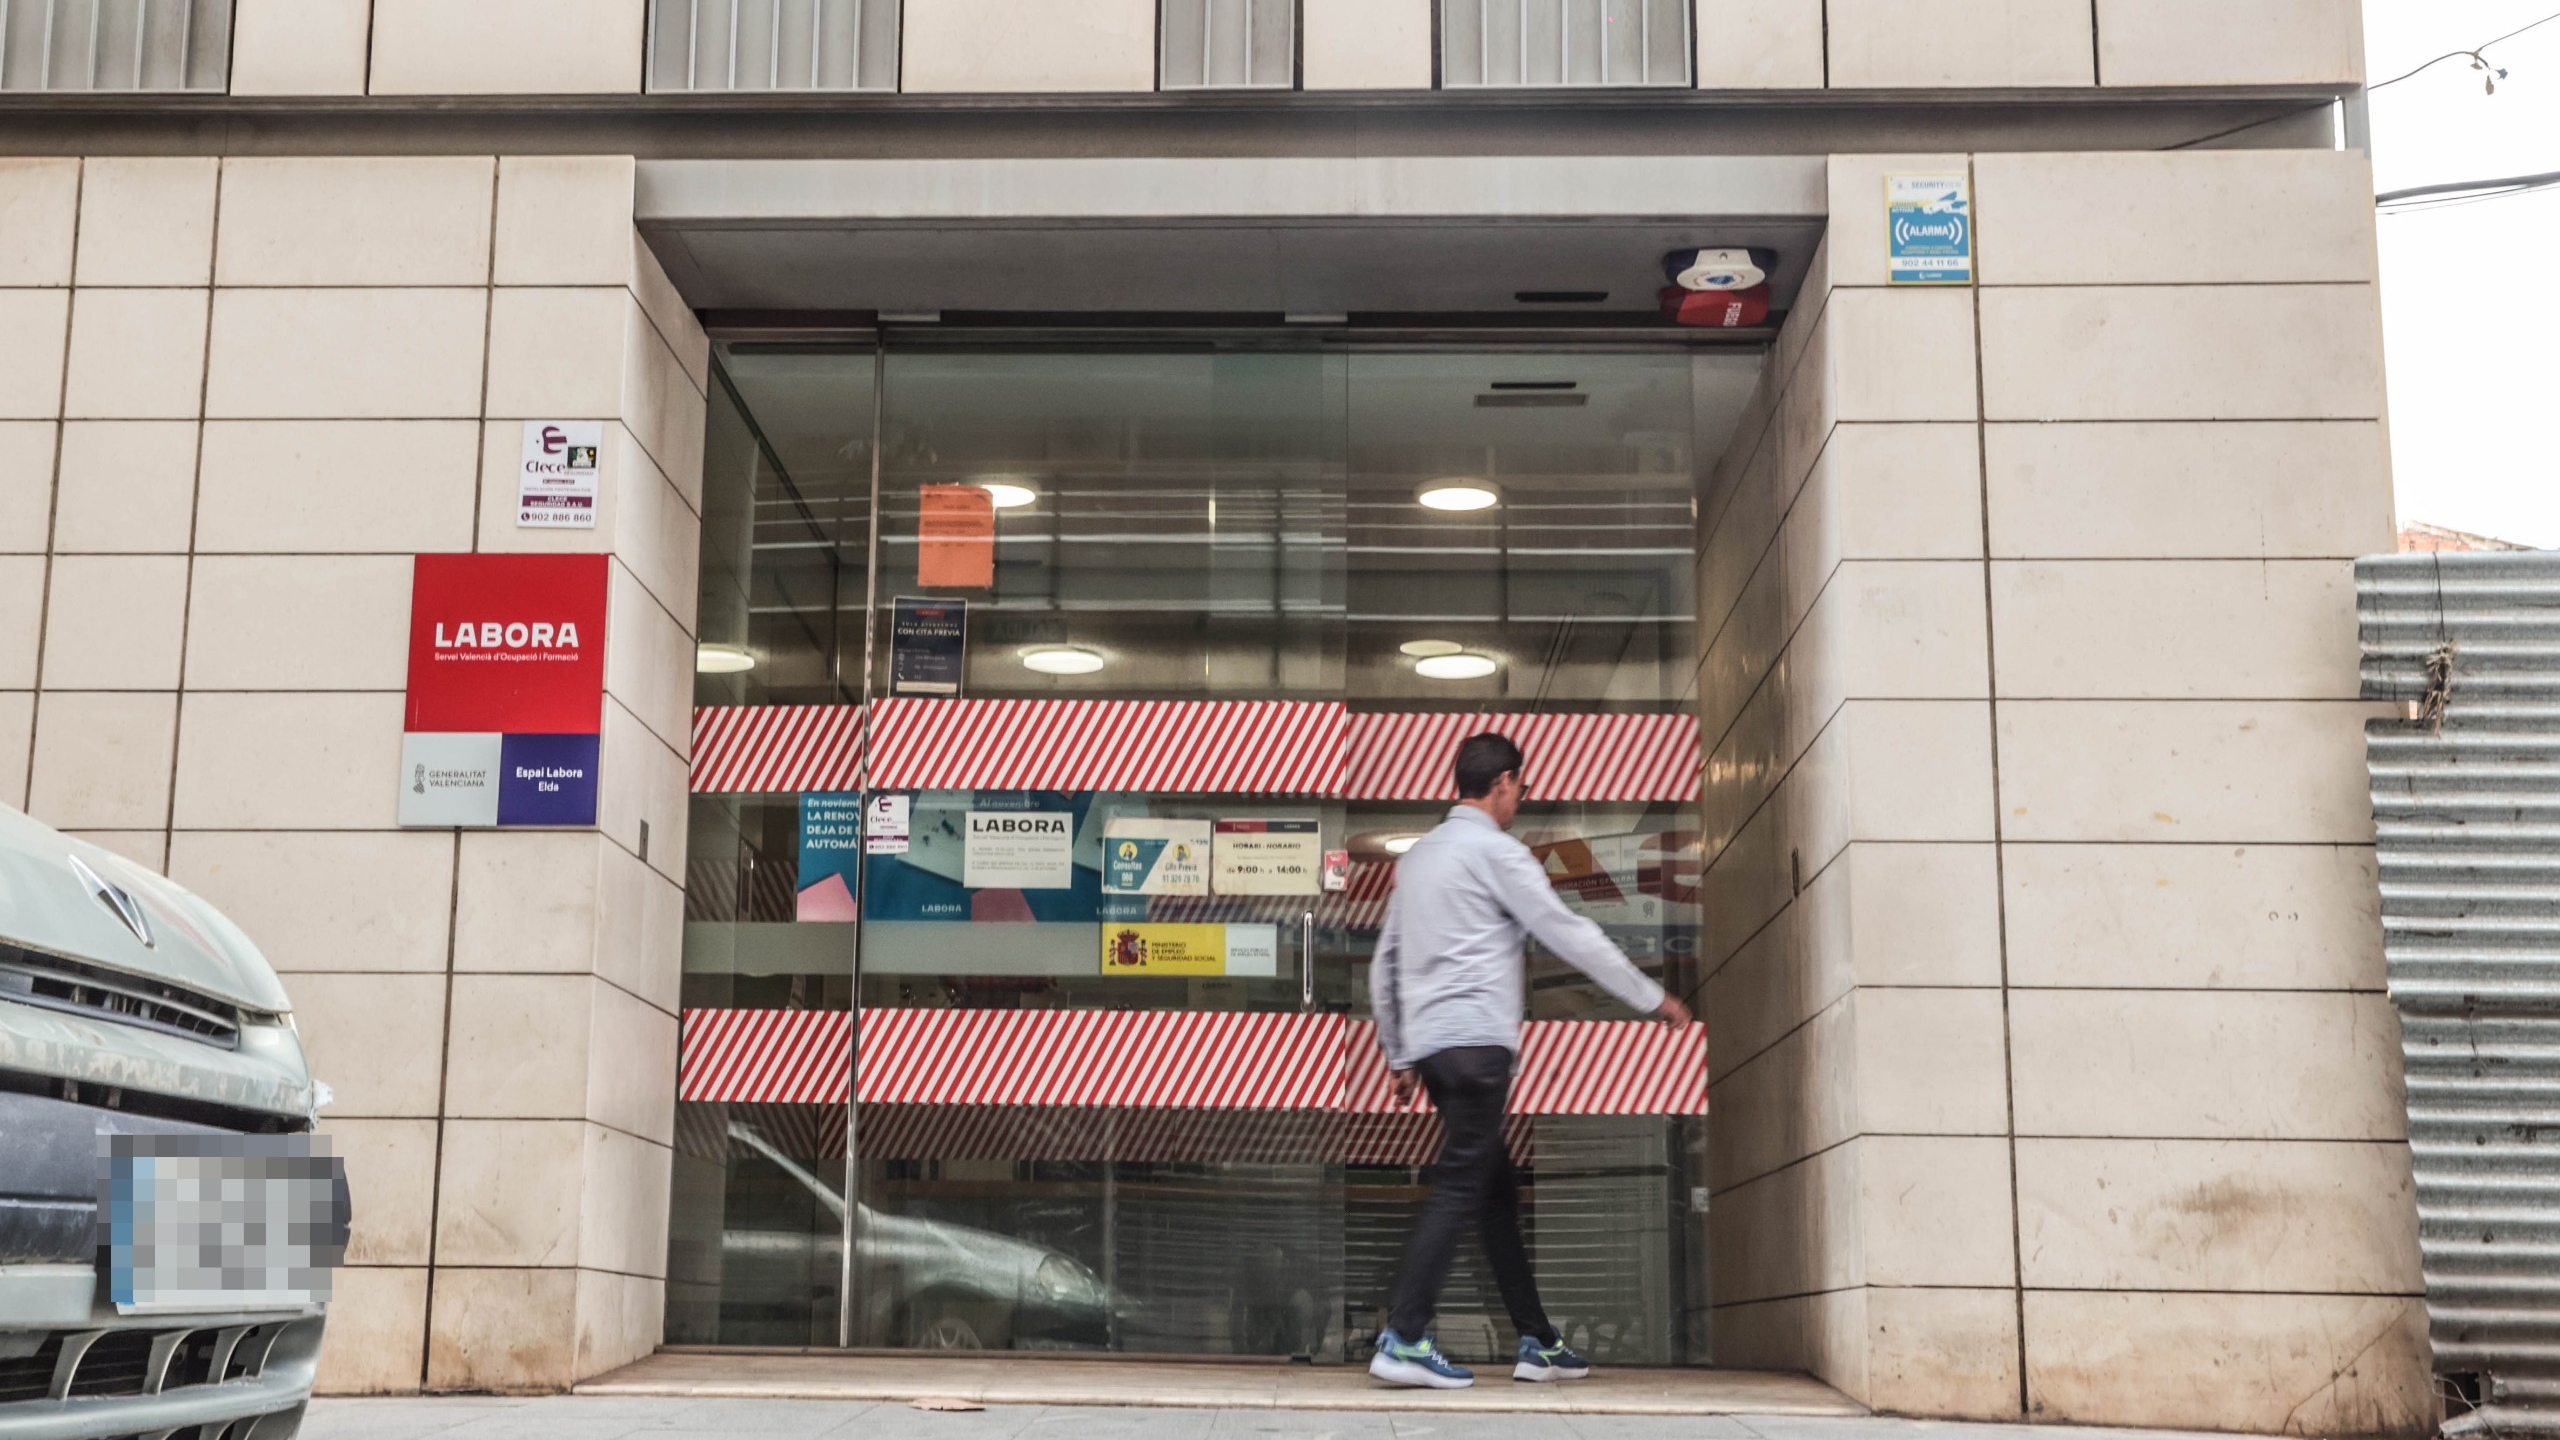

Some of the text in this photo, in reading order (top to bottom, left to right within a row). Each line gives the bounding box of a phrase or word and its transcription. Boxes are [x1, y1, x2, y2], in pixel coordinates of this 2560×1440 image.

[1910, 226, 1949, 236] ALARMA
[1902, 259, 1919, 267] 902
[1922, 259, 1934, 267] 44
[526, 460, 566, 474] Clece
[531, 512, 592, 523] 902 886 860
[435, 622, 579, 648] LABORA
[898, 628, 960, 637] CON CITA PREVIA
[434, 652, 458, 662] Servei
[460, 652, 492, 662] Valencià
[494, 652, 538, 664] d'Ocupació
[543, 652, 579, 662] Formació
[428, 770, 487, 779] GENERALITAT
[516, 766, 583, 780] Espai Labora
[429, 778, 485, 788] VALENCIANA
[538, 780, 560, 792] Elda
[808, 798, 820, 808] En
[807, 810, 822, 821] LA
[806, 825, 836, 835] DEJA
[838, 825, 852, 835] DE
[972, 819, 1066, 833] LABORA
[1232, 842, 1301, 850] HORARI HORARIO
[1113, 859, 1142, 870] Consultas
[1226, 866, 1236, 874] de
[1237, 866, 1258, 874] 9:00
[1277, 866, 1301, 874] 14:00
[921, 904, 962, 914] LABORA
